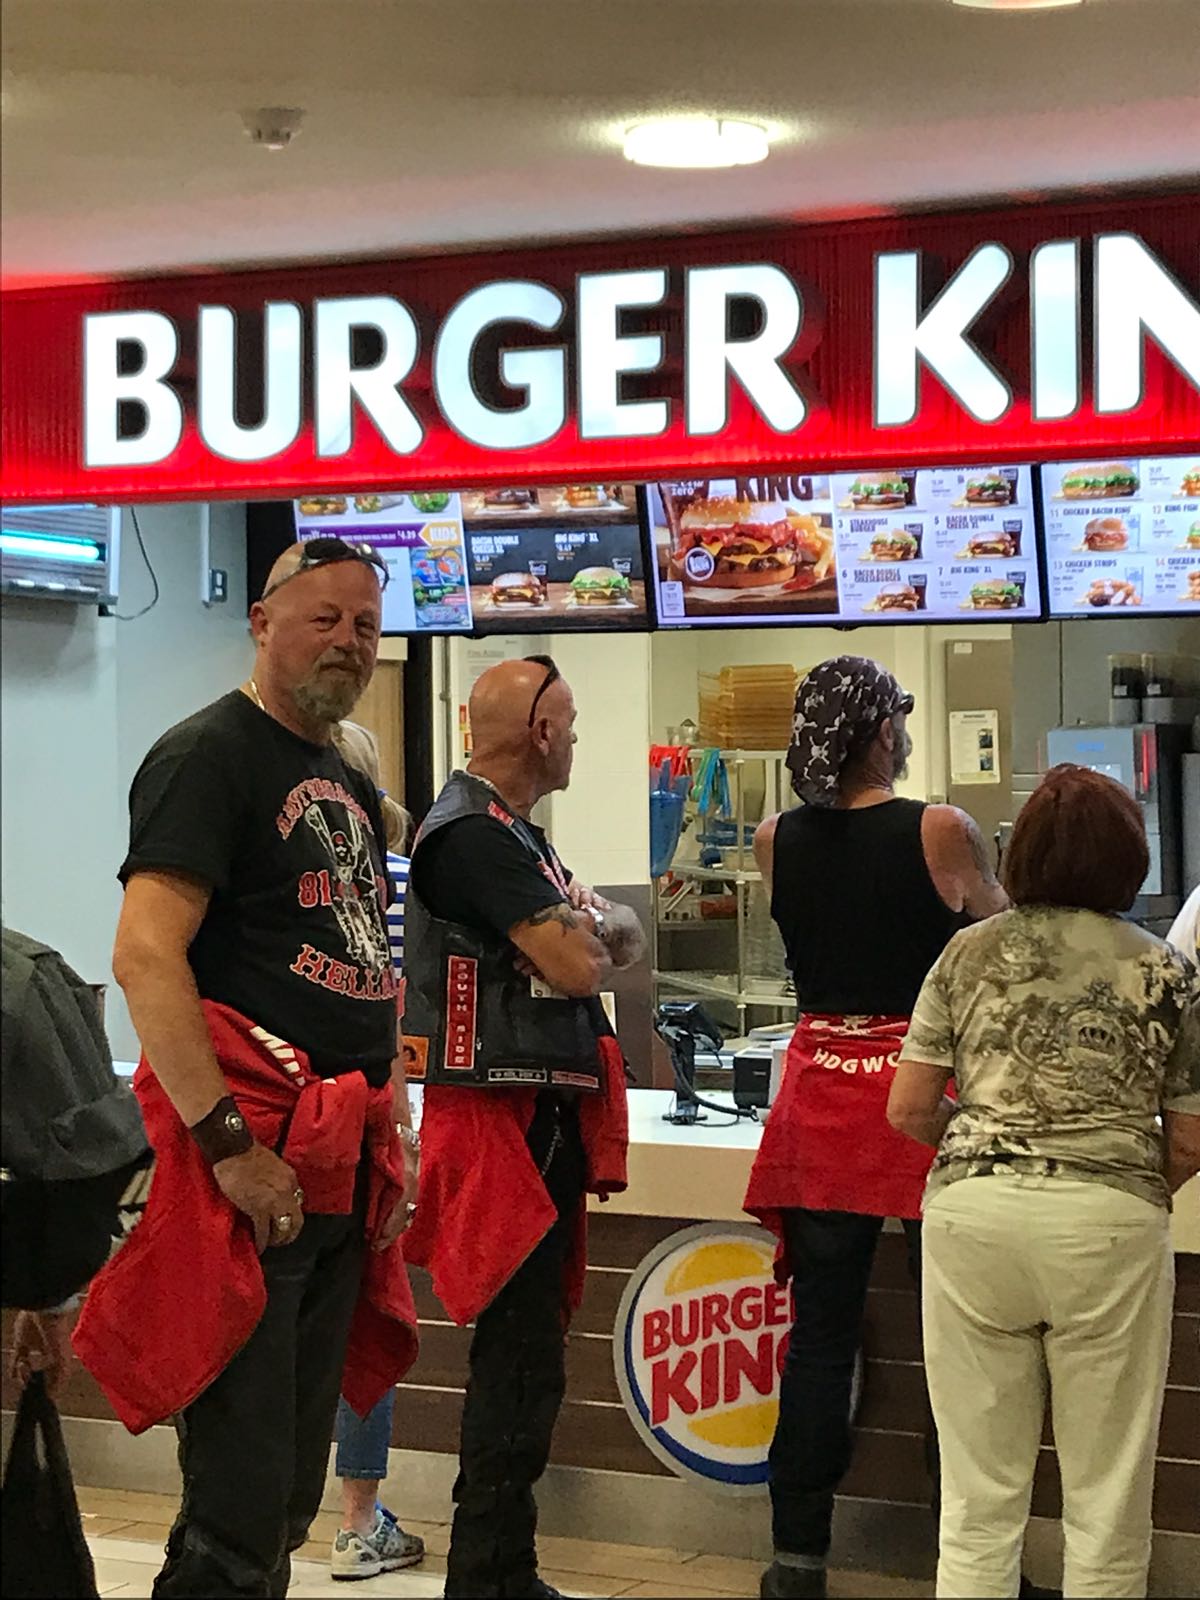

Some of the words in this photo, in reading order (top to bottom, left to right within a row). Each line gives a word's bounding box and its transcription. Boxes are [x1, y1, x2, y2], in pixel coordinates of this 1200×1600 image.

[84, 262, 808, 468] BURGER
[736, 476, 813, 502] KING
[1063, 507, 1090, 516] CHICKEN
[1114, 505, 1131, 514] KING
[1164, 503, 1182, 513] KING
[969, 513, 995, 522] DOUBLE
[430, 526, 458, 542] KIDS
[555, 533, 568, 543] BIG
[493, 535, 519, 545] DOUBLE
[1065, 559, 1092, 568] CHICKEN
[1094, 558, 1117, 567] STRIPS
[298, 869, 333, 908] 81
[643, 1281, 797, 1360] BURGE
